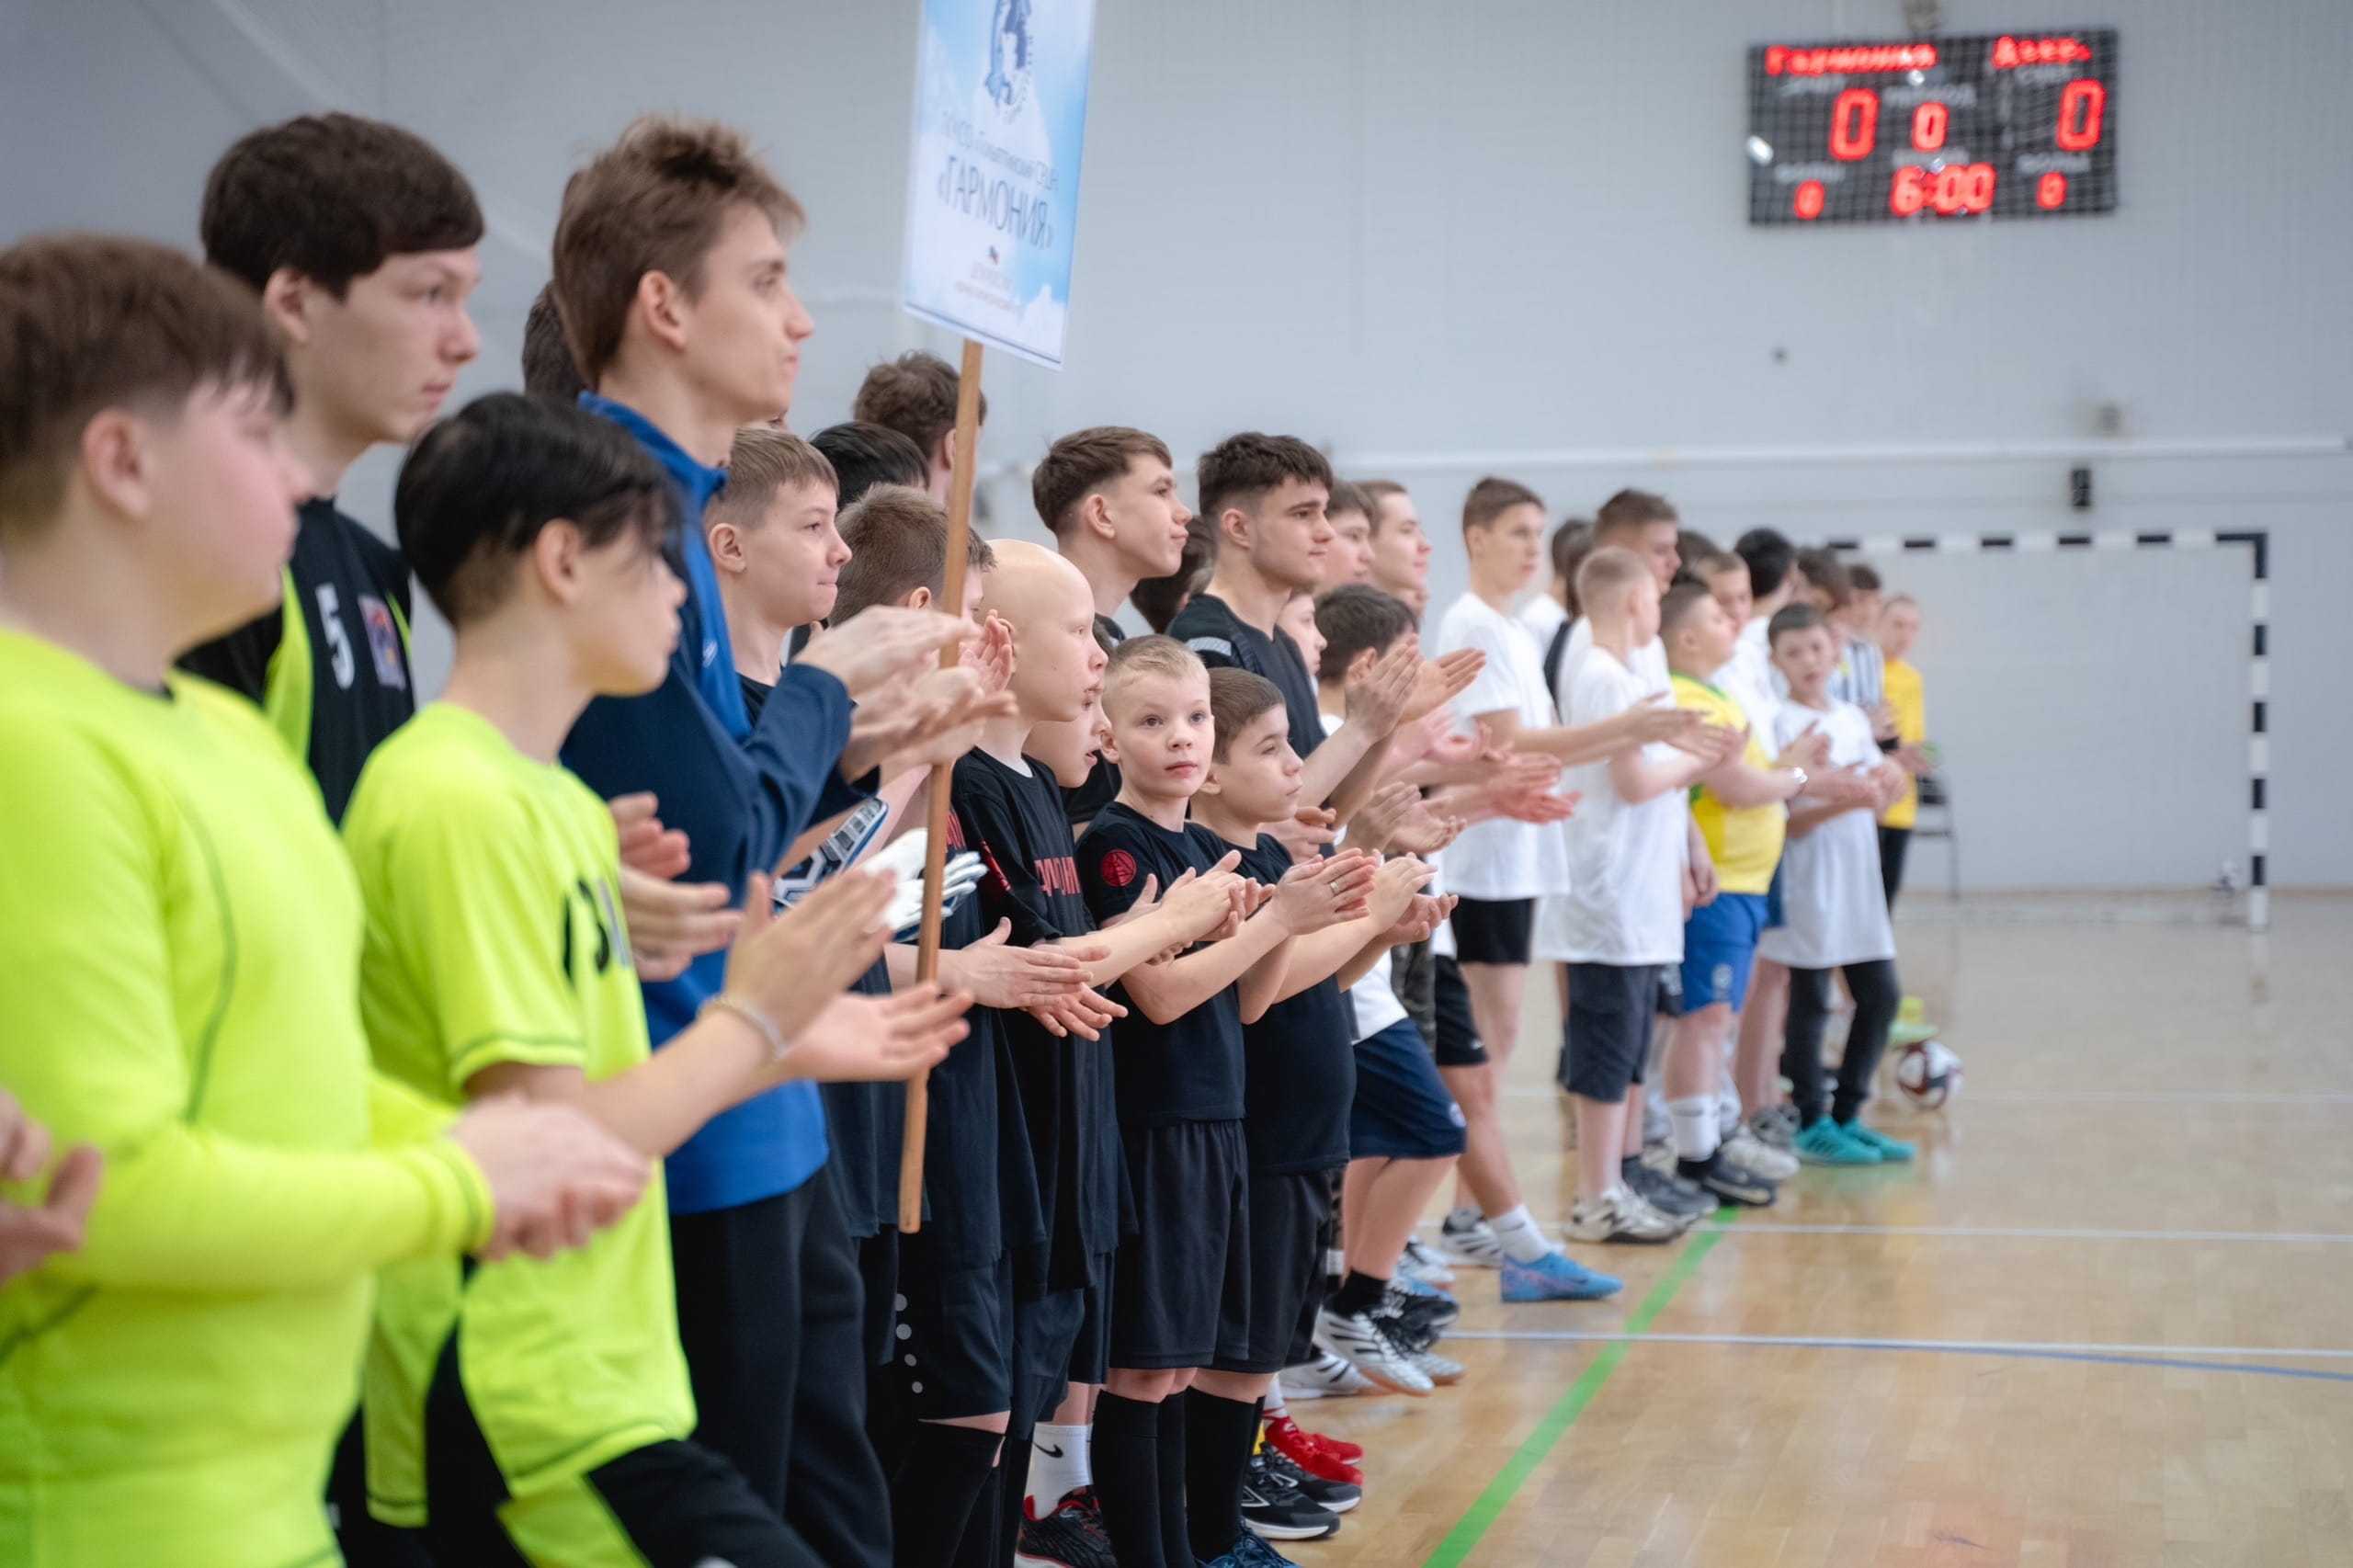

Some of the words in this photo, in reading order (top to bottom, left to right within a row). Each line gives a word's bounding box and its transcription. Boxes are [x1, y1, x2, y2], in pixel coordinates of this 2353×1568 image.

[1829, 88, 1879, 161] 0
[1913, 102, 1949, 152] 0
[2056, 78, 2106, 151] 0
[1892, 164, 1996, 216] 6:00
[315, 583, 355, 689] 5
